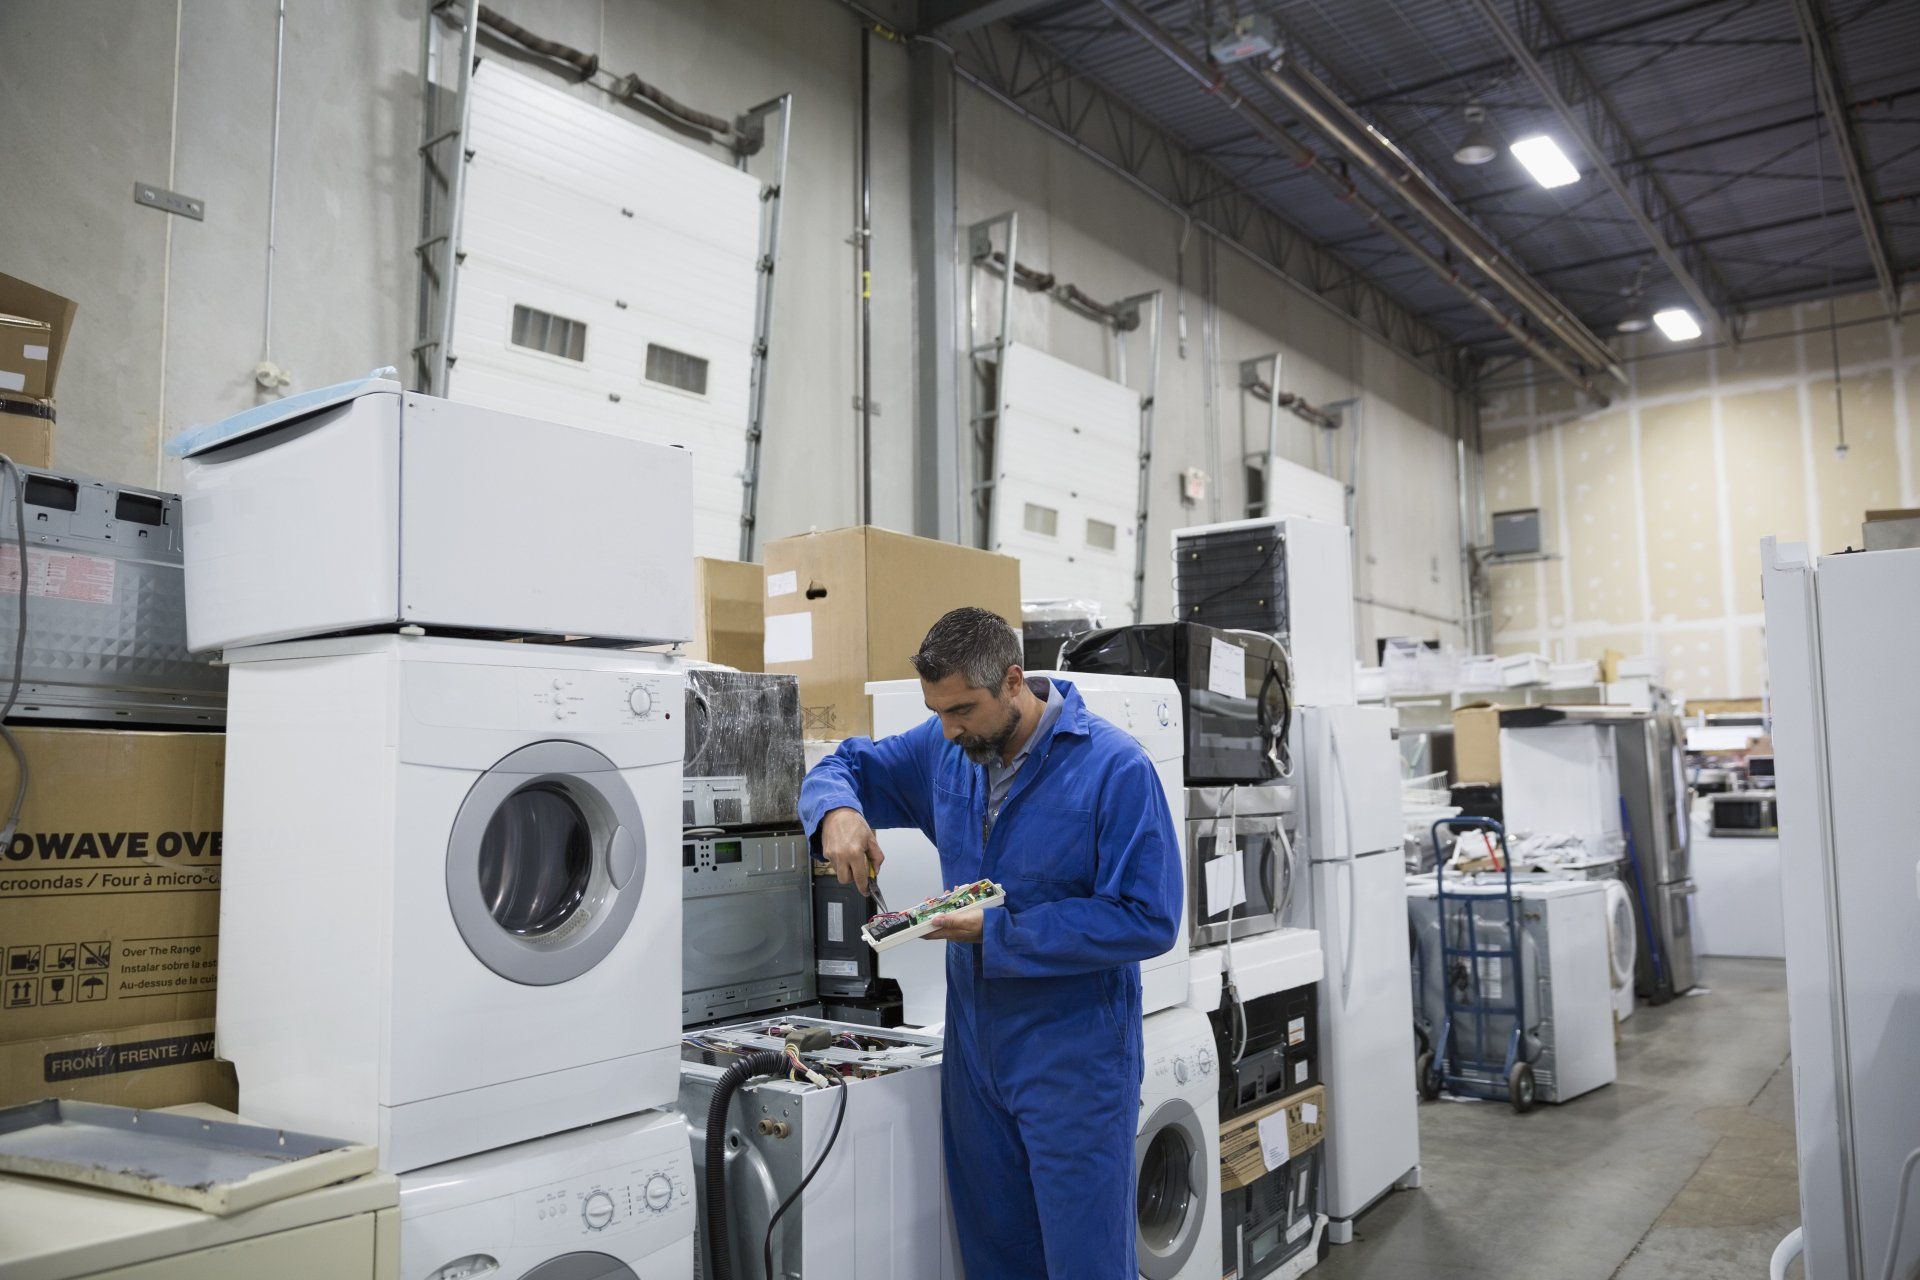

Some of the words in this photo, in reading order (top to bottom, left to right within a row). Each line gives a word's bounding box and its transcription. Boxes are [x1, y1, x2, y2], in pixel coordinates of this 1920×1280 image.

[0, 831, 149, 861] OWAVE
[86, 872, 99, 888] /
[102, 873, 139, 887] Four
[143, 872, 152, 886] à
[122, 947, 147, 957] Over
[149, 946, 168, 955] The
[170, 945, 202, 955] Range
[121, 963, 160, 974] Instalar
[161, 961, 189, 971] sobre
[191, 960, 200, 969] la
[120, 979, 173, 990] Au-dessus
[175, 977, 188, 986] de
[189, 976, 198, 985] la
[51, 1054, 106, 1074] FRONT
[109, 1053, 116, 1066] /
[119, 1045, 178, 1064] FRENTE
[182, 1043, 188, 1056] /
